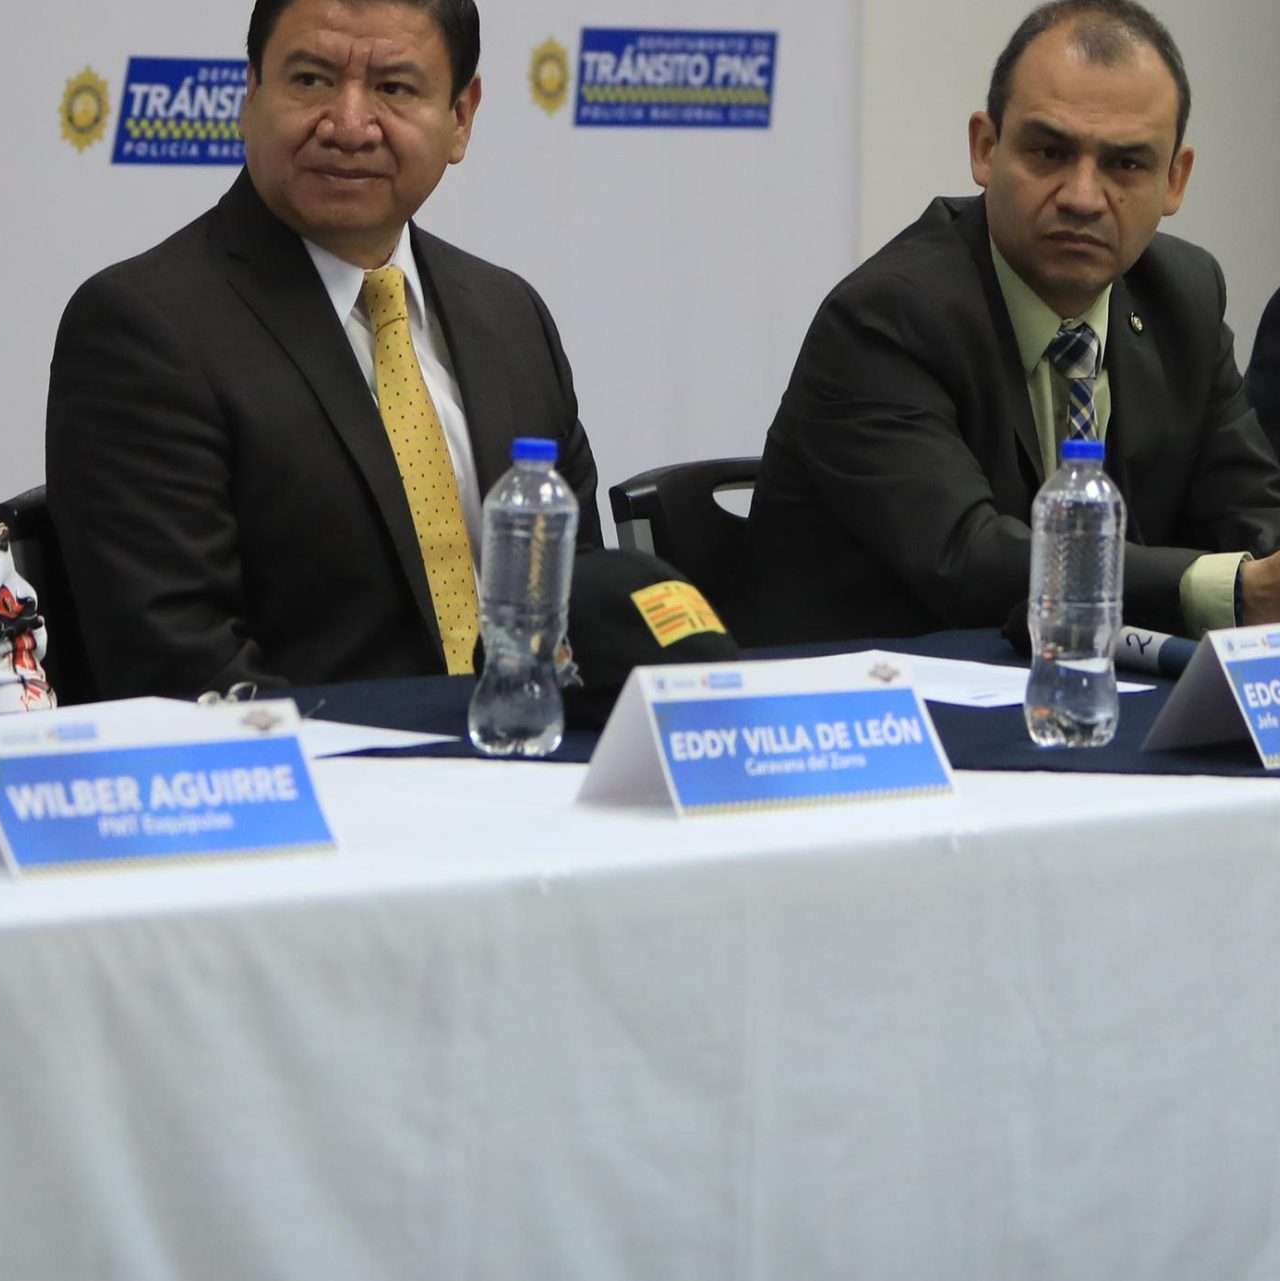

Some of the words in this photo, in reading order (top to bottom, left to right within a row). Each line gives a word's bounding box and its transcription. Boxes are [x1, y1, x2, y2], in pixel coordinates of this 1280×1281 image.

[582, 44, 709, 86] TRÁNSITO
[714, 54, 770, 87] PNC
[670, 727, 737, 761] EDDY
[742, 724, 814, 754] VILLA
[816, 722, 852, 750] DE
[855, 712, 922, 747] LEÓN
[7, 776, 140, 820] WILBER
[150, 765, 298, 810] AGUIRRE
